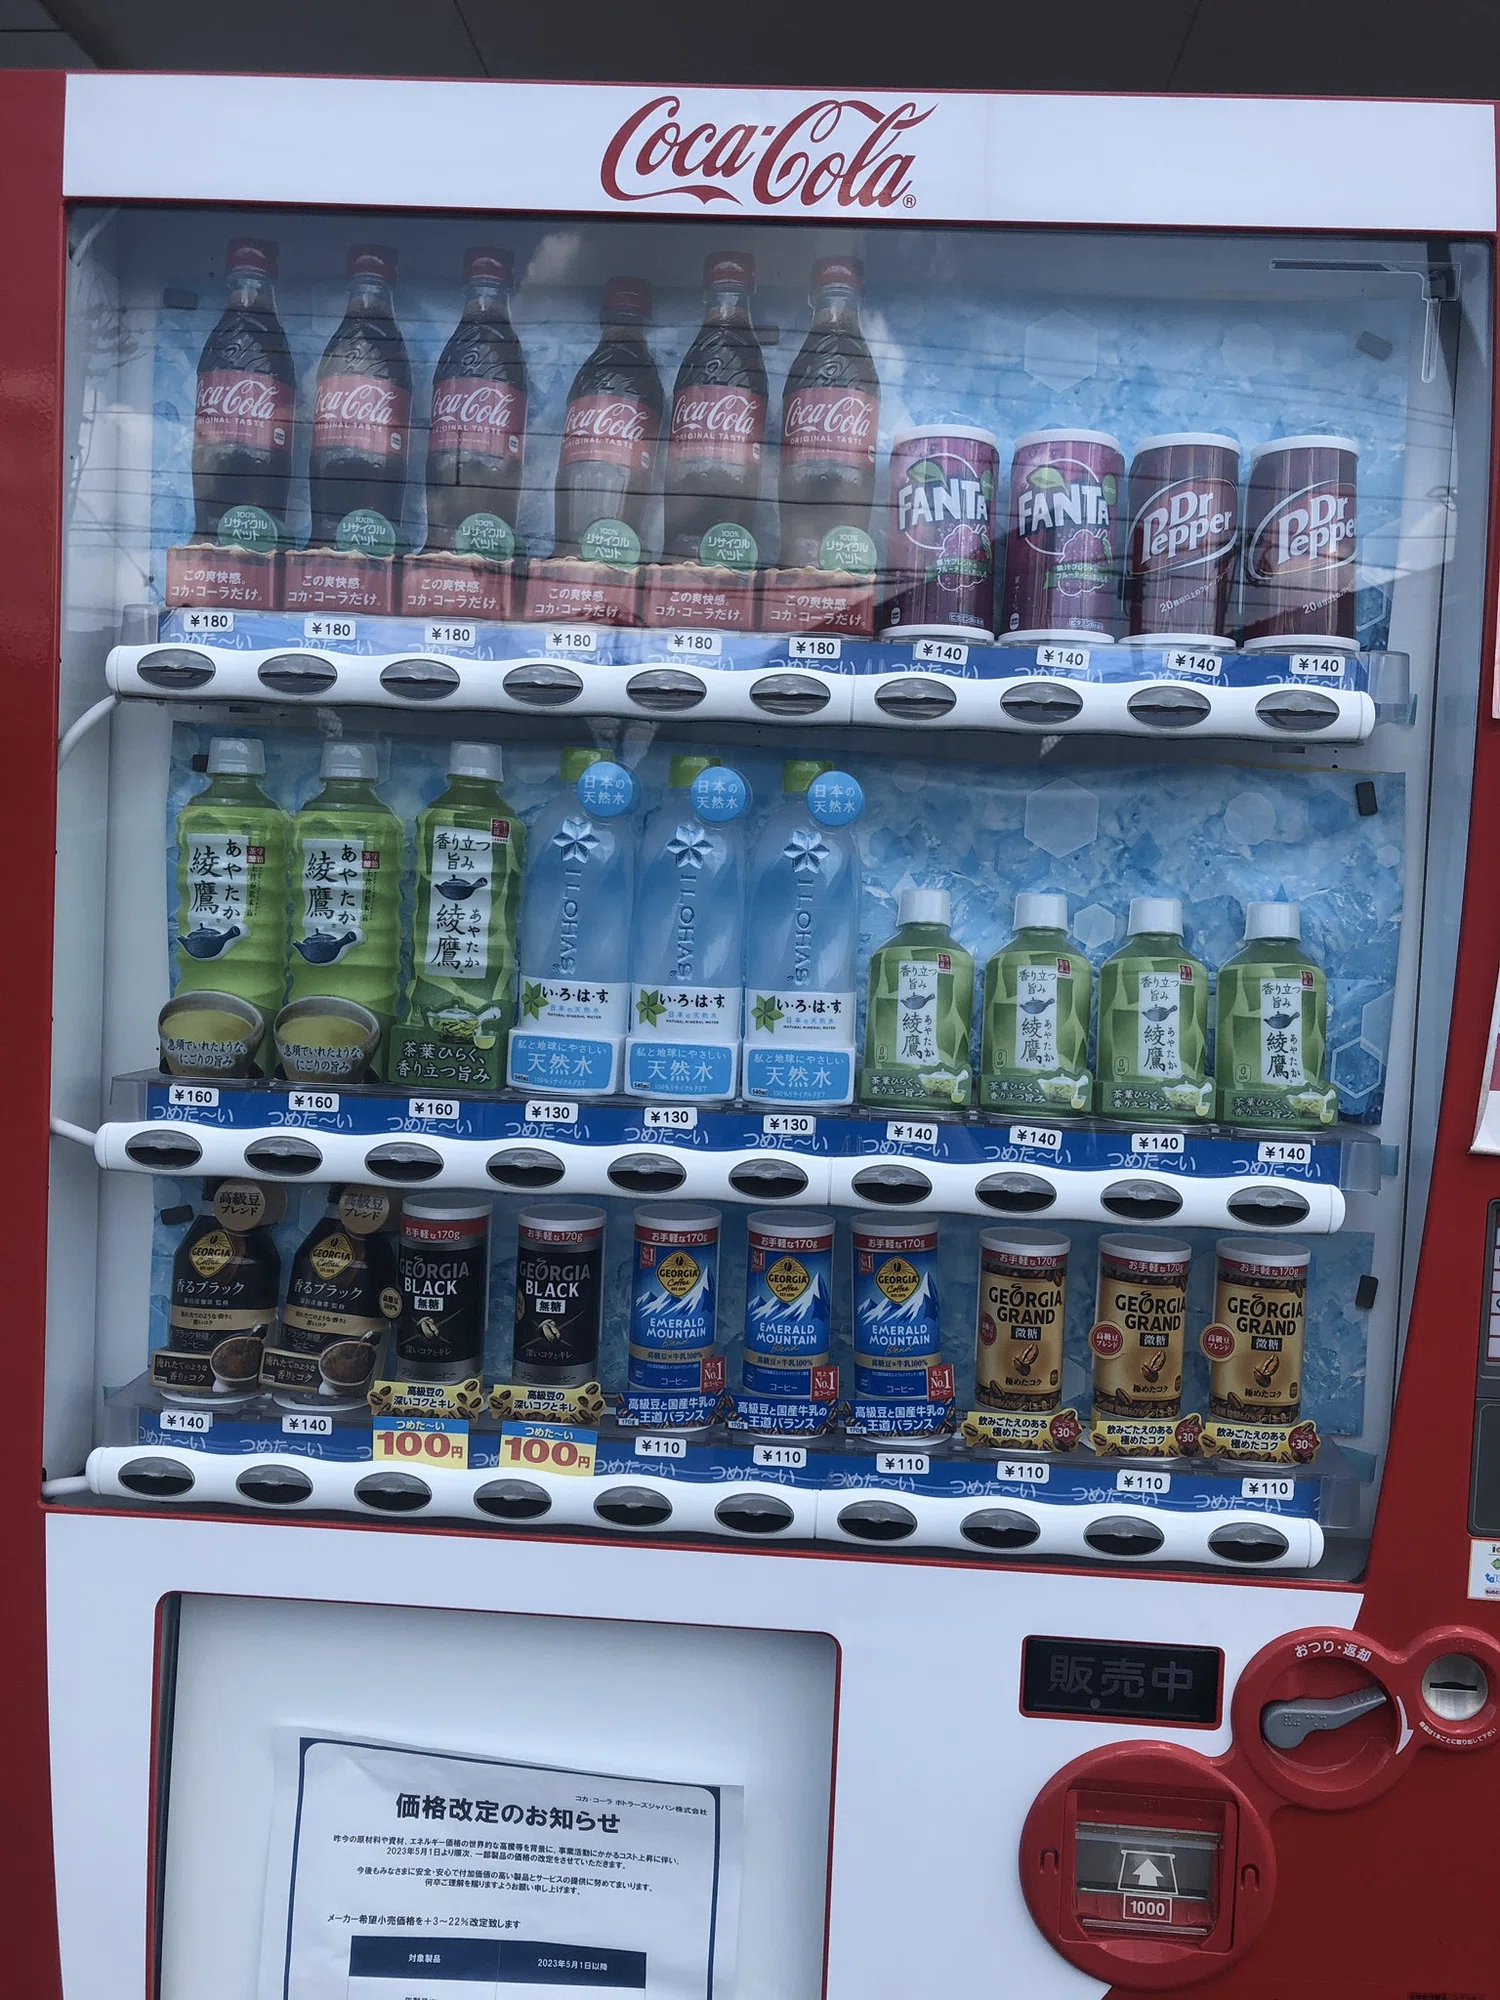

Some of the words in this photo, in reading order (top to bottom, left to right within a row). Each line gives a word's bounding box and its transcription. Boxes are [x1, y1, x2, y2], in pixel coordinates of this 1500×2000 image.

[600, 96, 939, 208] Coca-Cola
[672, 394, 757, 433] Coca-Cola
[785, 396, 873, 437] Coca-Cola
[675, 434, 713, 443] ORIGINAL
[719, 435, 746, 443] TASTE
[790, 436, 831, 445] ORIGINAL
[836, 438, 862, 446] TASTE
[899, 478, 987, 531] FANTA
[1019, 482, 1109, 537] FANTA
[1171, 490, 1213, 523] Dr
[1308, 494, 1348, 525] Dr
[1141, 506, 1232, 565] Pepper
[1277, 513, 1357, 571] Peppe
[708, 537, 750, 549] リサイクル
[826, 540, 868, 553] リサイクル
[717, 549, 743, 560] ペット
[835, 552, 862, 564] ペット
[184, 570, 246, 585] この爽快感。
[421, 579, 484, 594] この爽快感。
[670, 591, 730, 606] この爽快感。
[191, 615, 228, 628] ¥180
[312, 623, 350, 637] ¥180
[432, 628, 470, 641] ¥180
[553, 634, 591, 647] ¥180
[674, 636, 712, 649] ¥180
[796, 641, 834, 655] ¥180
[923, 644, 962, 660] ¥140
[1044, 650, 1084, 666] ¥140
[1176, 655, 1216, 672] ¥140
[1299, 658, 1339, 674] ¥140
[584, 775, 625, 789] 日本の
[698, 780, 737, 793] 日本の
[583, 791, 625, 805] 天然水
[815, 784, 854, 798] 日本の
[697, 797, 738, 809] 天然水
[814, 800, 855, 813] 天然水
[435, 833, 491, 851] 香り立つ
[447, 852, 474, 871] 旨み
[189, 845, 223, 915] 綾鷹
[223, 839, 242, 919] あやたか
[305, 851, 338, 920] 綾鷹
[338, 844, 357, 925] あやたか
[431, 903, 466, 970] 綾鷹
[465, 908, 482, 968] あやたか
[900, 964, 937, 977] 香り立つ
[1019, 969, 1056, 982] 香り立つ
[909, 978, 927, 989] 旨み
[1027, 982, 1046, 994] 旨み
[1141, 975, 1180, 988] 香り立つ
[1150, 990, 1169, 1002] 旨み
[1262, 983, 1301, 996] 香り立つ
[1272, 996, 1291, 1008] 旨み
[902, 1012, 923, 1060] 綾鷹
[924, 1015, 934, 1057] あやたか
[1021, 1017, 1043, 1065] 綾鷹
[1044, 1019, 1055, 1062] あやたか
[517, 1039, 607, 1055] 私と地球にやさしい
[1144, 1025, 1166, 1072] 綾鷹
[1167, 1027, 1177, 1070] あやたか
[180, 1053, 233, 1068] にごりの旨み
[1267, 1031, 1289, 1080] 綾鷹
[1289, 1034, 1301, 1078] あやたか
[527, 1052, 593, 1077] 天然水
[648, 1060, 713, 1082] 天然水
[397, 1061, 490, 1083] 香り立つ旨み
[766, 1066, 832, 1088] 天然水
[175, 1089, 212, 1103] ¥160
[871, 1087, 927, 1098] 香り立つ旨み
[295, 1095, 333, 1108] ¥160
[415, 1102, 452, 1116] ¥160
[532, 1106, 569, 1119] ¥130
[651, 1111, 689, 1123] ¥130
[770, 1118, 808, 1131] ¥130
[894, 1125, 932, 1141] ¥140
[1017, 1129, 1056, 1145] ¥140
[1139, 1137, 1178, 1150] ¥140
[1266, 1146, 1305, 1160] ¥140
[219, 1191, 261, 1206] 高級豆
[221, 1205, 258, 1215] ブレンド
[400, 1254, 470, 1280] GEORGIA
[520, 1257, 590, 1281] GEORGIA
[660, 1269, 698, 1278] GEORGIA
[405, 1277, 457, 1295] BLACK
[769, 1274, 807, 1284] GEORGIA
[176, 1278, 246, 1296] 香るブラック
[526, 1280, 579, 1298] BLACK
[989, 1283, 1062, 1307] GEORGIA
[417, 1298, 439, 1310] 無糖
[539, 1300, 562, 1313] 無糖
[1115, 1290, 1186, 1315] GEORGIA
[1227, 1293, 1303, 1318] GEORGIA
[650, 1317, 704, 1328] EMERALD
[997, 1306, 1055, 1325] GRAND
[1125, 1314, 1181, 1331] GRAND
[646, 1327, 706, 1338] MOUNTAIN
[760, 1323, 814, 1334] EMERALD
[872, 1324, 927, 1335] EMERALD
[1015, 1328, 1038, 1339] 微糖
[1237, 1317, 1296, 1336] GRAND
[757, 1334, 817, 1345] MOUNTAIN
[870, 1335, 930, 1345] MOUNTAIN
[1256, 1338, 1279, 1350] 微糖
[407, 1386, 444, 1397] 高級豆の
[528, 1390, 565, 1401] 高級豆の
[394, 1395, 455, 1410] 深いコクとキレ
[514, 1399, 576, 1412] 深いコクとキレ
[629, 1397, 716, 1411] 高級豆と国産牛乳の
[738, 1401, 827, 1417] 高級豆と国産牛乳の
[167, 1414, 204, 1429] ¥140
[640, 1410, 705, 1424] 王道バランス
[748, 1416, 815, 1429] 王道バランス
[978, 1416, 1047, 1429] 飲みごたえのある
[289, 1417, 327, 1432] ¥140
[992, 1427, 1039, 1438] 極めたコク
[377, 1432, 462, 1459] 100円
[505, 1437, 590, 1468] 100円
[642, 1440, 680, 1453] ¥110
[763, 1449, 801, 1463] ¥110
[886, 1458, 924, 1470] ¥110
[1006, 1466, 1044, 1479] ¥110
[1124, 1476, 1163, 1489] ¥110
[1249, 1482, 1288, 1495] ¥110
[1050, 1653, 1193, 1702] 販売中
[396, 1793, 619, 1834] 価格改定のお知らせ
[1130, 1900, 1165, 1916] 1000
[408, 1953, 441, 1964] 対象製品
[538, 1958, 608, 1972] 2023年5月1日以降
